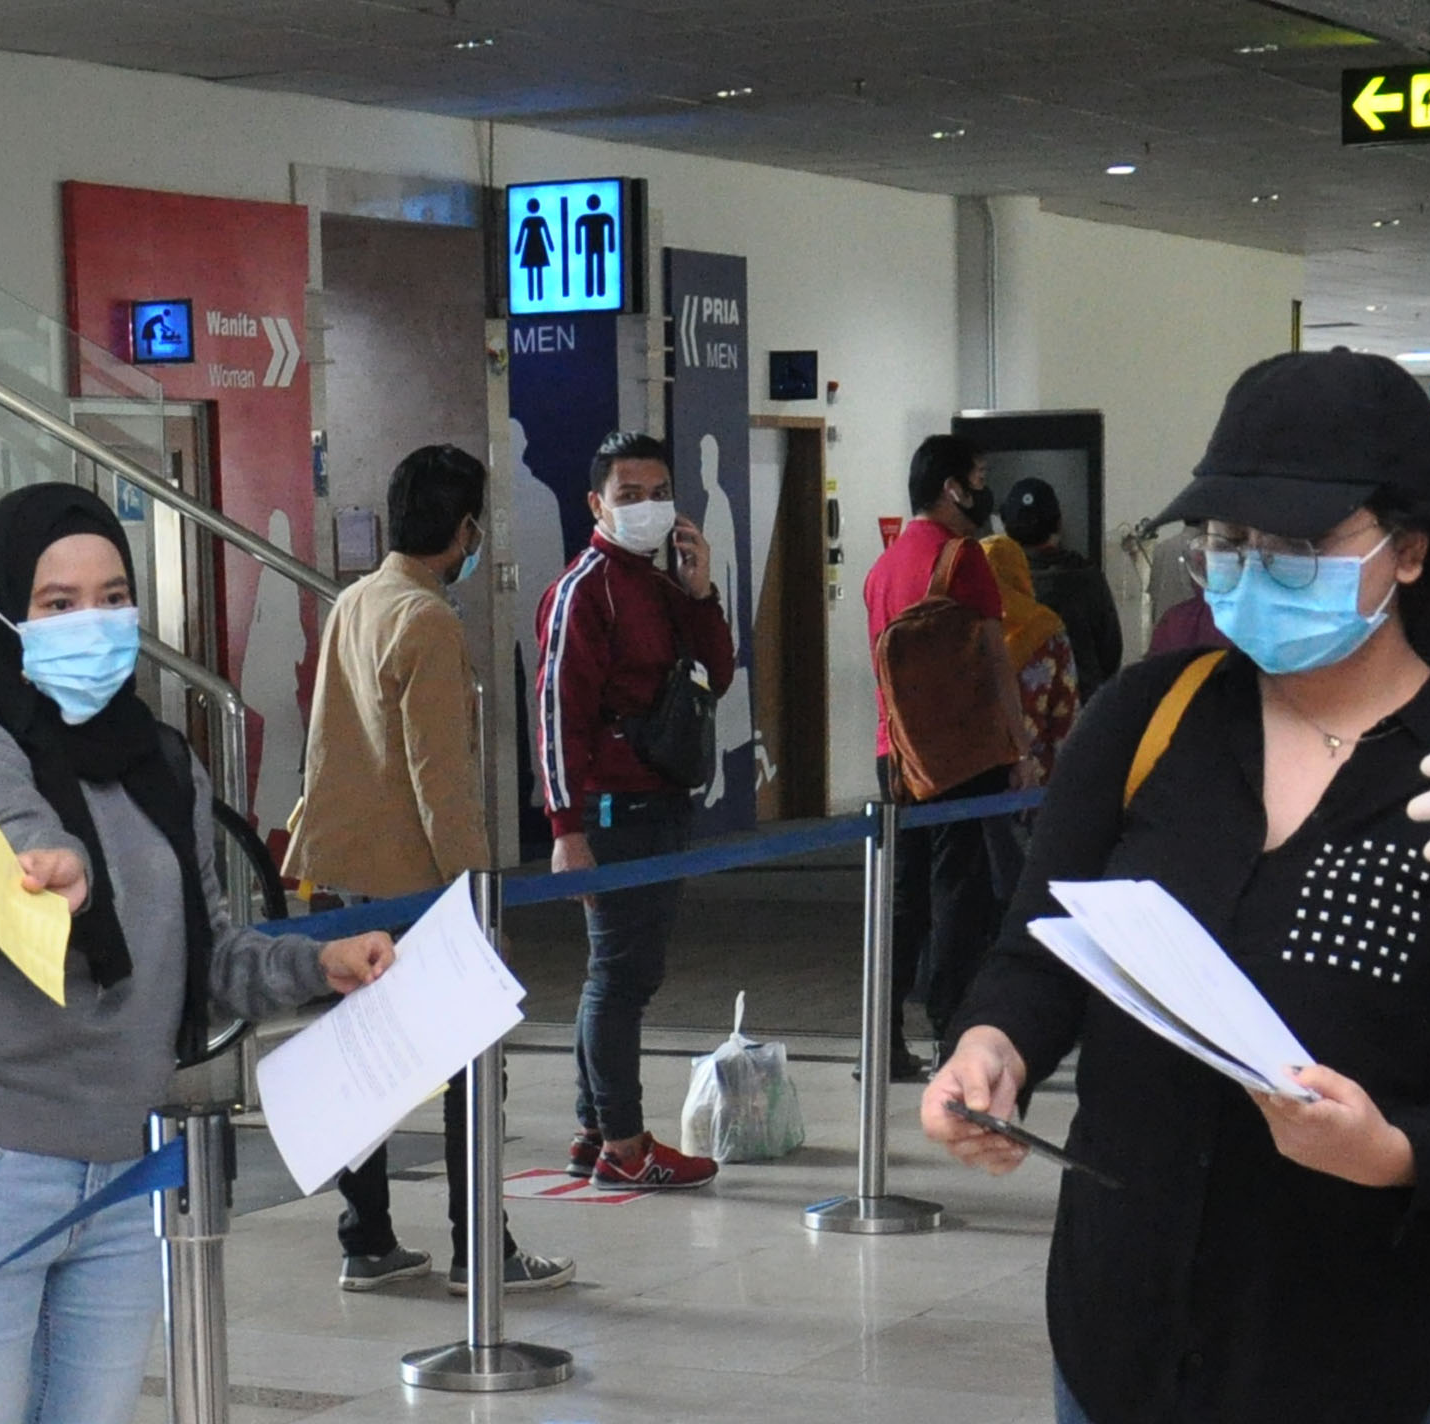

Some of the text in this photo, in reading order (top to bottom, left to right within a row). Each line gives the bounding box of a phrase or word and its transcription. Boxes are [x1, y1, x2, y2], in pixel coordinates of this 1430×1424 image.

[206, 311, 258, 338] Wanita
[702, 297, 739, 325] PRIA
[514, 325, 576, 354] MEN
[706, 344, 739, 369] MEN
[209, 364, 256, 389] Woman
